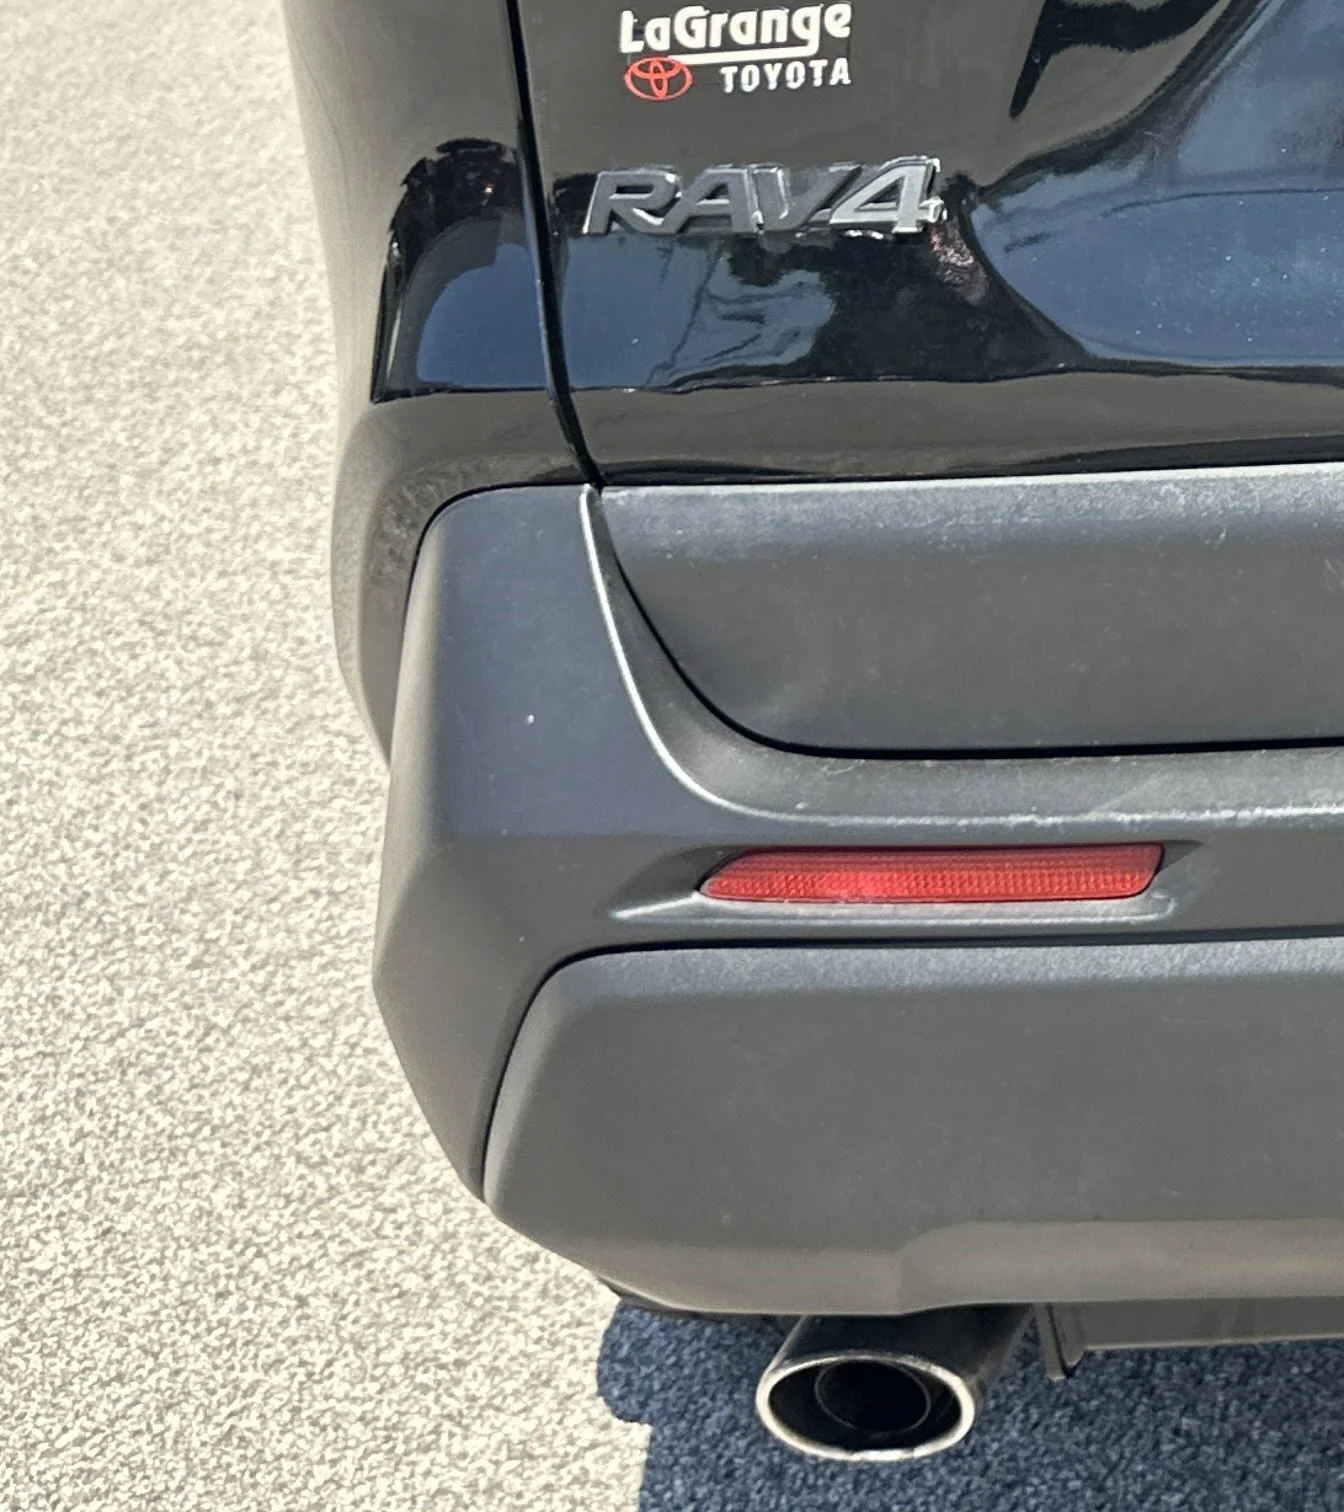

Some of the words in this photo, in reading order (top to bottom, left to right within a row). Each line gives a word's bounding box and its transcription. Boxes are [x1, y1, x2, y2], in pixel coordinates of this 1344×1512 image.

[619, 1, 852, 66] LaGrange
[719, 57, 852, 94] TOYOTA
[582, 154, 946, 237] RAV4
